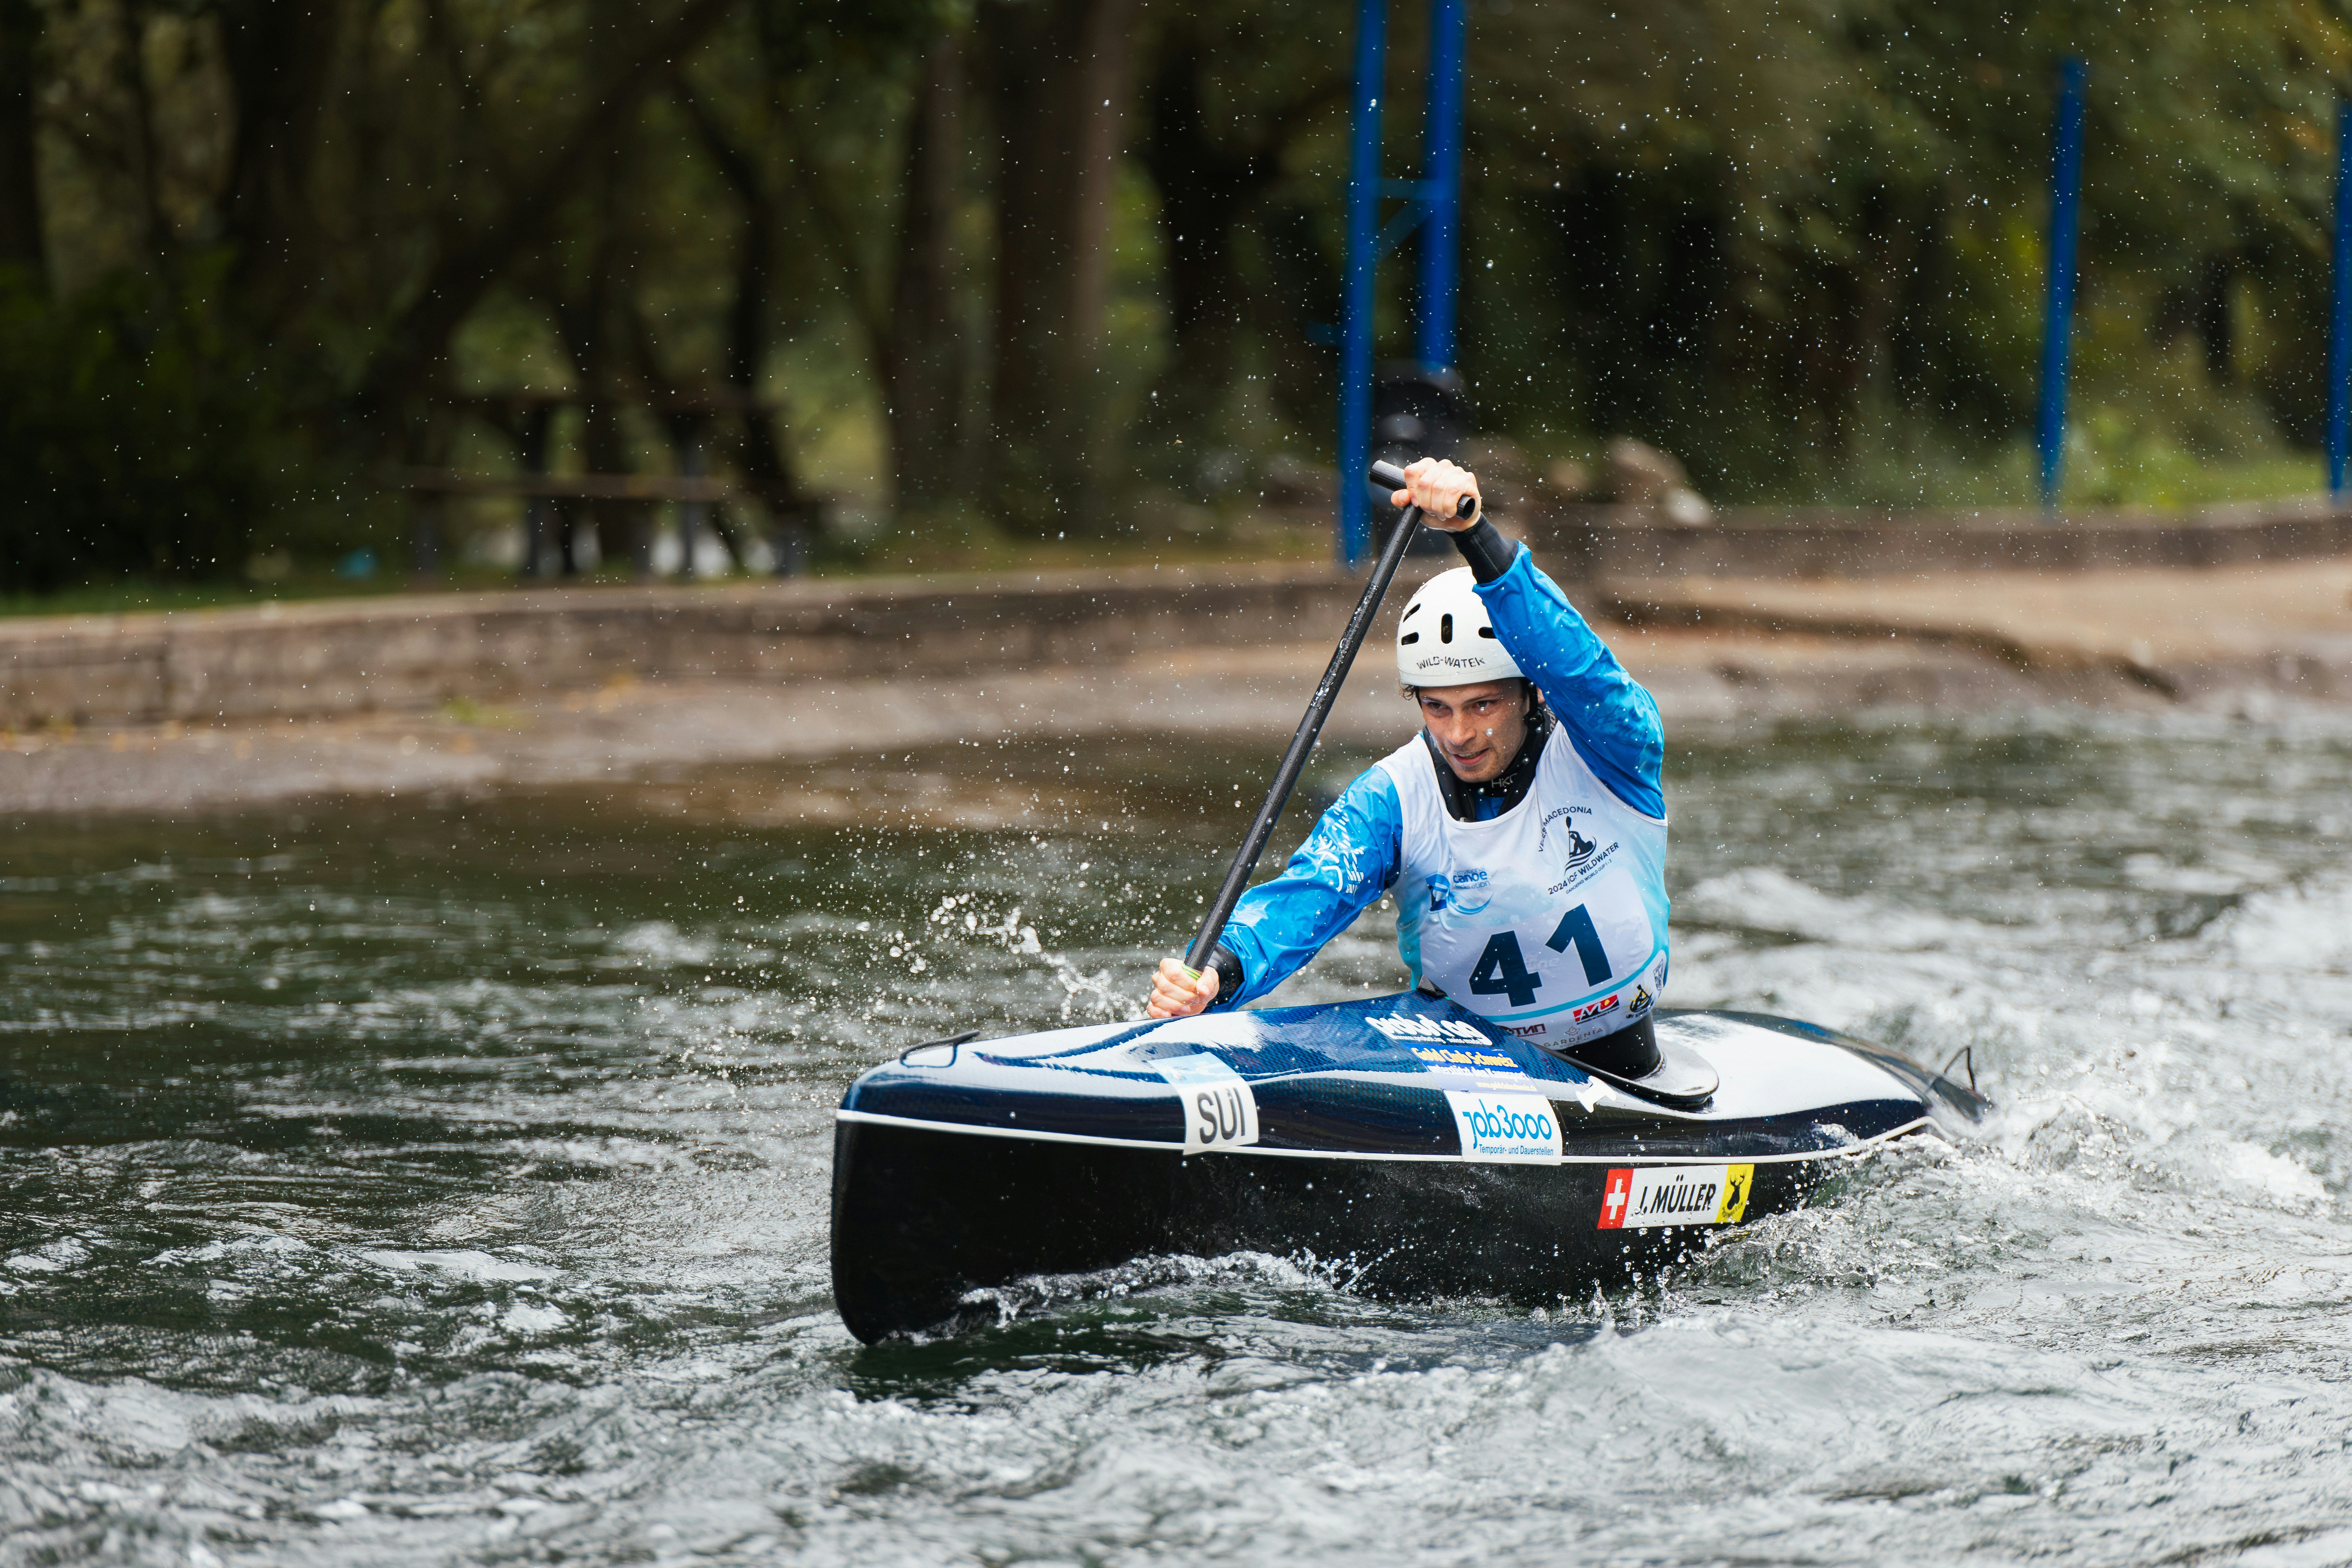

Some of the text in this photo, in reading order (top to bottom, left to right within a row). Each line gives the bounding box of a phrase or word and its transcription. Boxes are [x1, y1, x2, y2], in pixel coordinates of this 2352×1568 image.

[1543, 806, 1592, 826] MACEDONIA
[1453, 871, 1487, 884] canoe
[1548, 842, 1619, 895] 2024 ICF WILDWATER
[1584, 870, 1598, 881] WORLD
[1469, 903, 1613, 1007] 41
[1544, 1028, 1602, 1047] GARDENIA
[1411, 1047, 1519, 1068] Gold Club Schweiz
[1470, 1066, 1489, 1078] den
[1197, 1087, 1245, 1144] SUI
[1462, 1099, 1552, 1149] job3000
[1479, 1144, 1553, 1156] Temporär- und Dauerstellen
[1635, 1186, 1647, 1215] J.
[1650, 1174, 1716, 1214] MÜLLER
